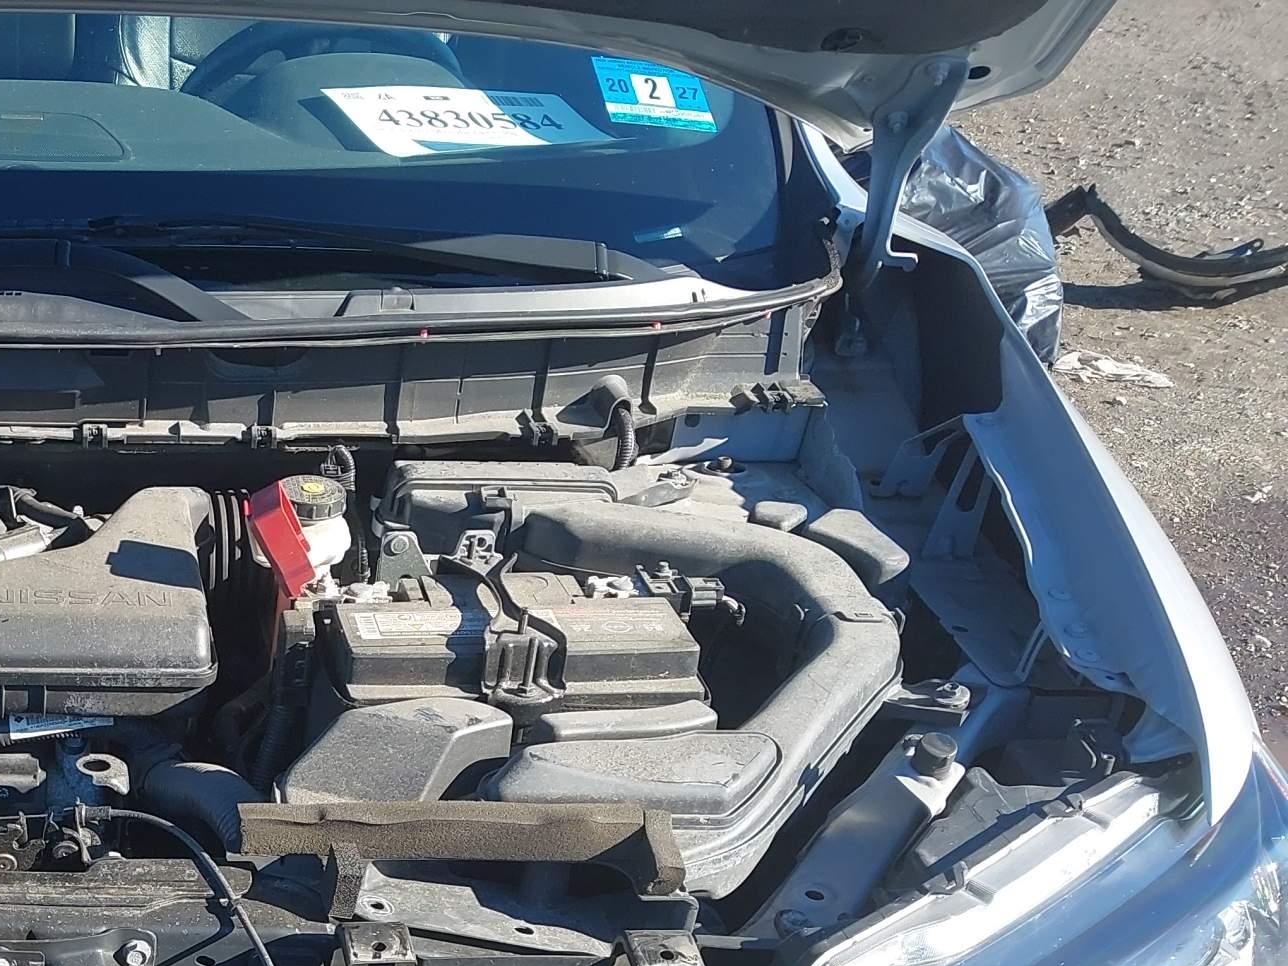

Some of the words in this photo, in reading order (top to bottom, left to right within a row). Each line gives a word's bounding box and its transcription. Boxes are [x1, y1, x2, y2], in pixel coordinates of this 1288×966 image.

[605, 77, 630, 94] 20
[643, 77, 661, 100] 2
[675, 86, 699, 101] 27
[377, 107, 565, 131] 43830584
